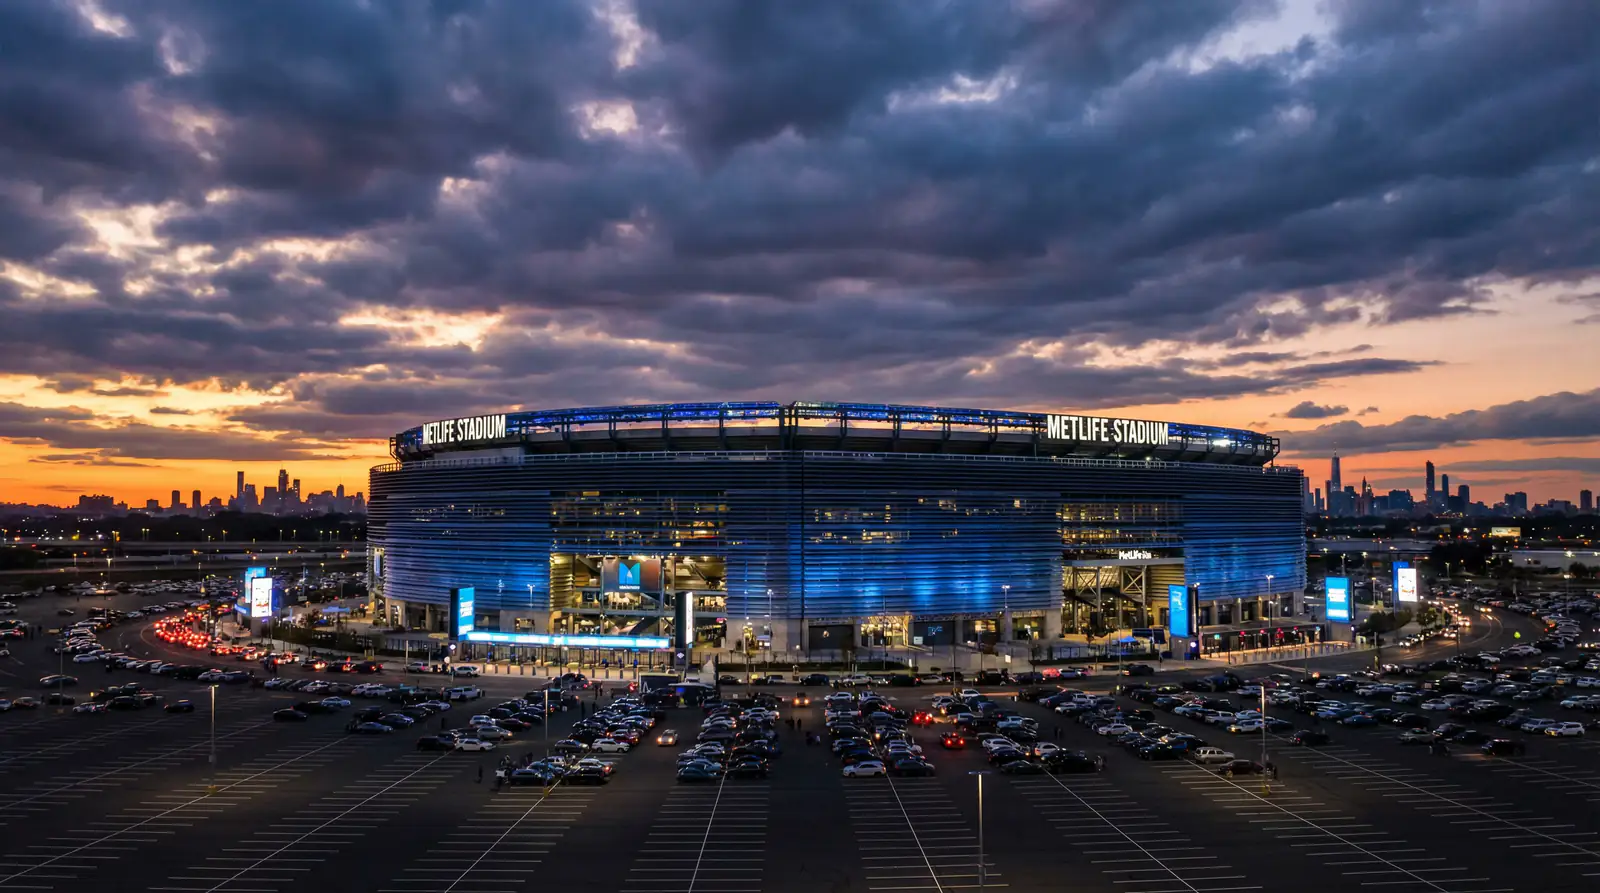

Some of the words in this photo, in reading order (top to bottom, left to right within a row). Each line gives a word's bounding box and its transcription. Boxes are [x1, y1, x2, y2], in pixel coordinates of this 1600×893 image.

[423, 420, 455, 445] METLIFE
[457, 414, 506, 442] STADIUM
[1047, 414, 1109, 442] METLIFE
[1113, 419, 1169, 445] STADIUM
